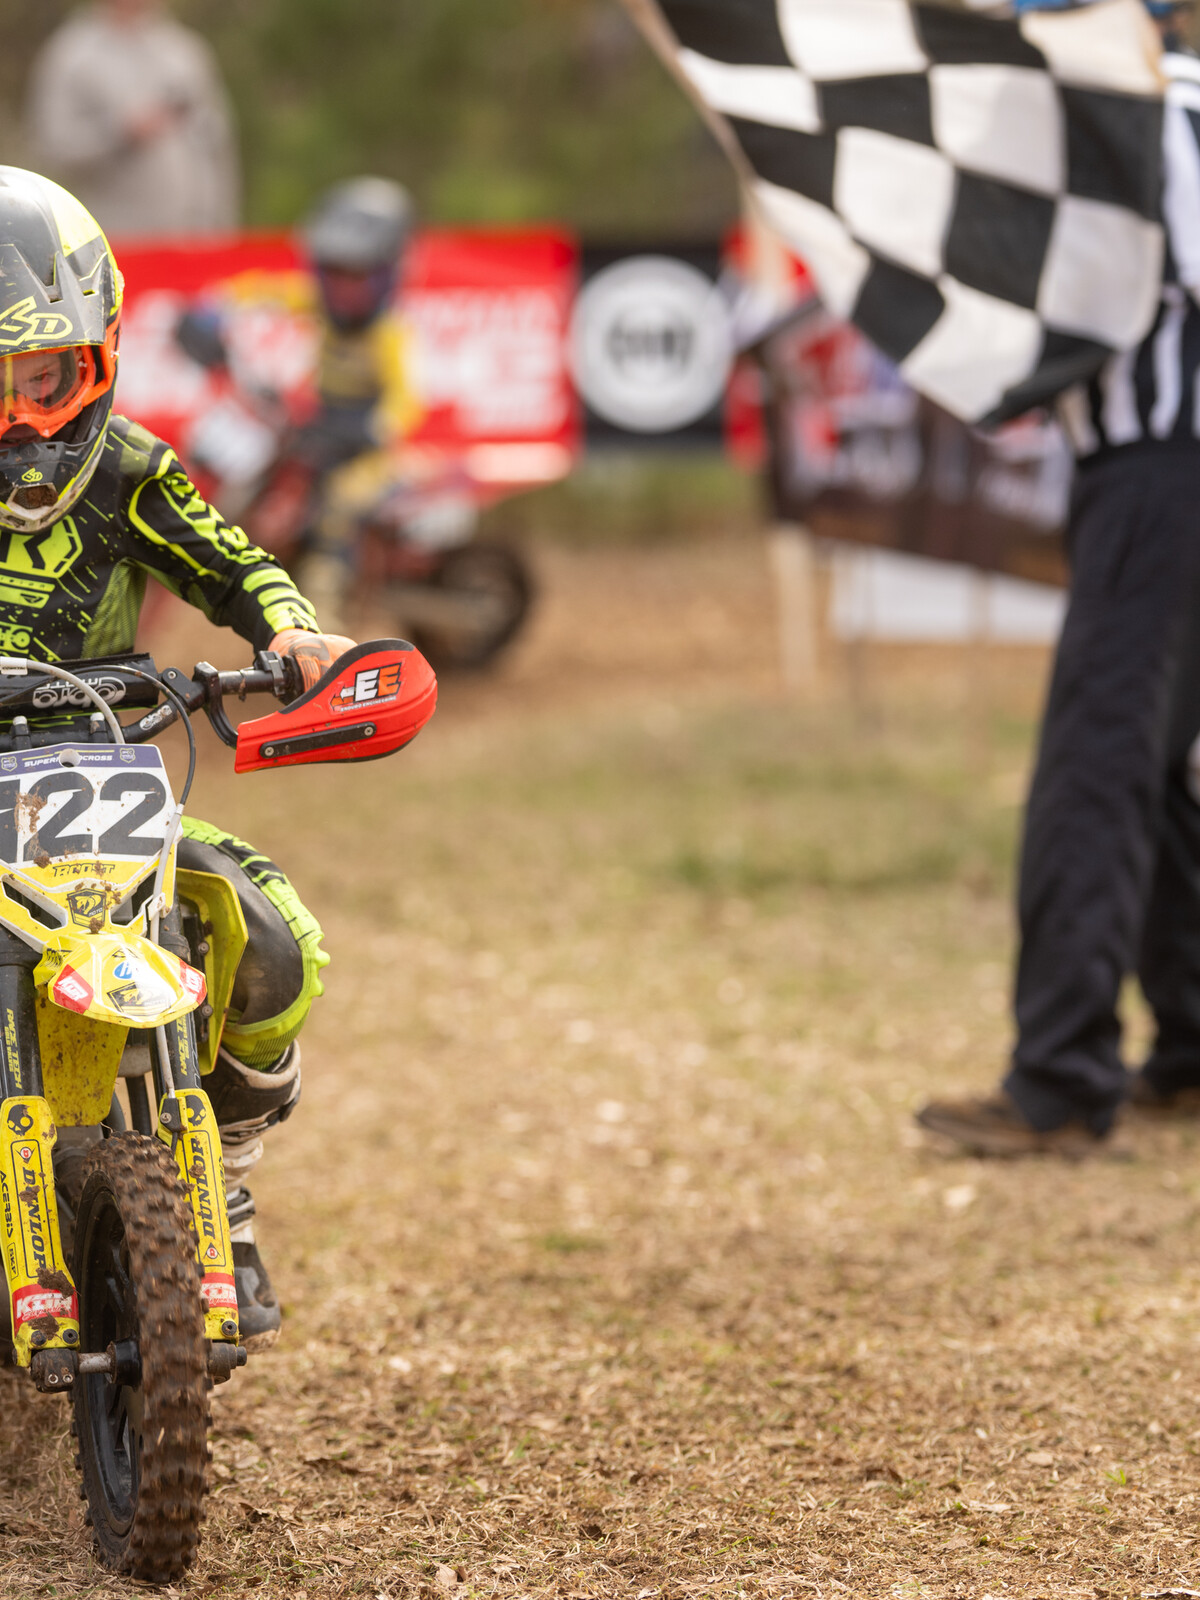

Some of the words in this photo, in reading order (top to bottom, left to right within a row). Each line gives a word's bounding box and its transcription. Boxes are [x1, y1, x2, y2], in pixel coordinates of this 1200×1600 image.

[353, 662, 402, 703] EE
[23, 754, 113, 768] SUPEROCROSS
[6, 1008, 18, 1048] RACE
[11, 1050, 23, 1090] TECH
[22, 1167, 47, 1273] DNLOP
